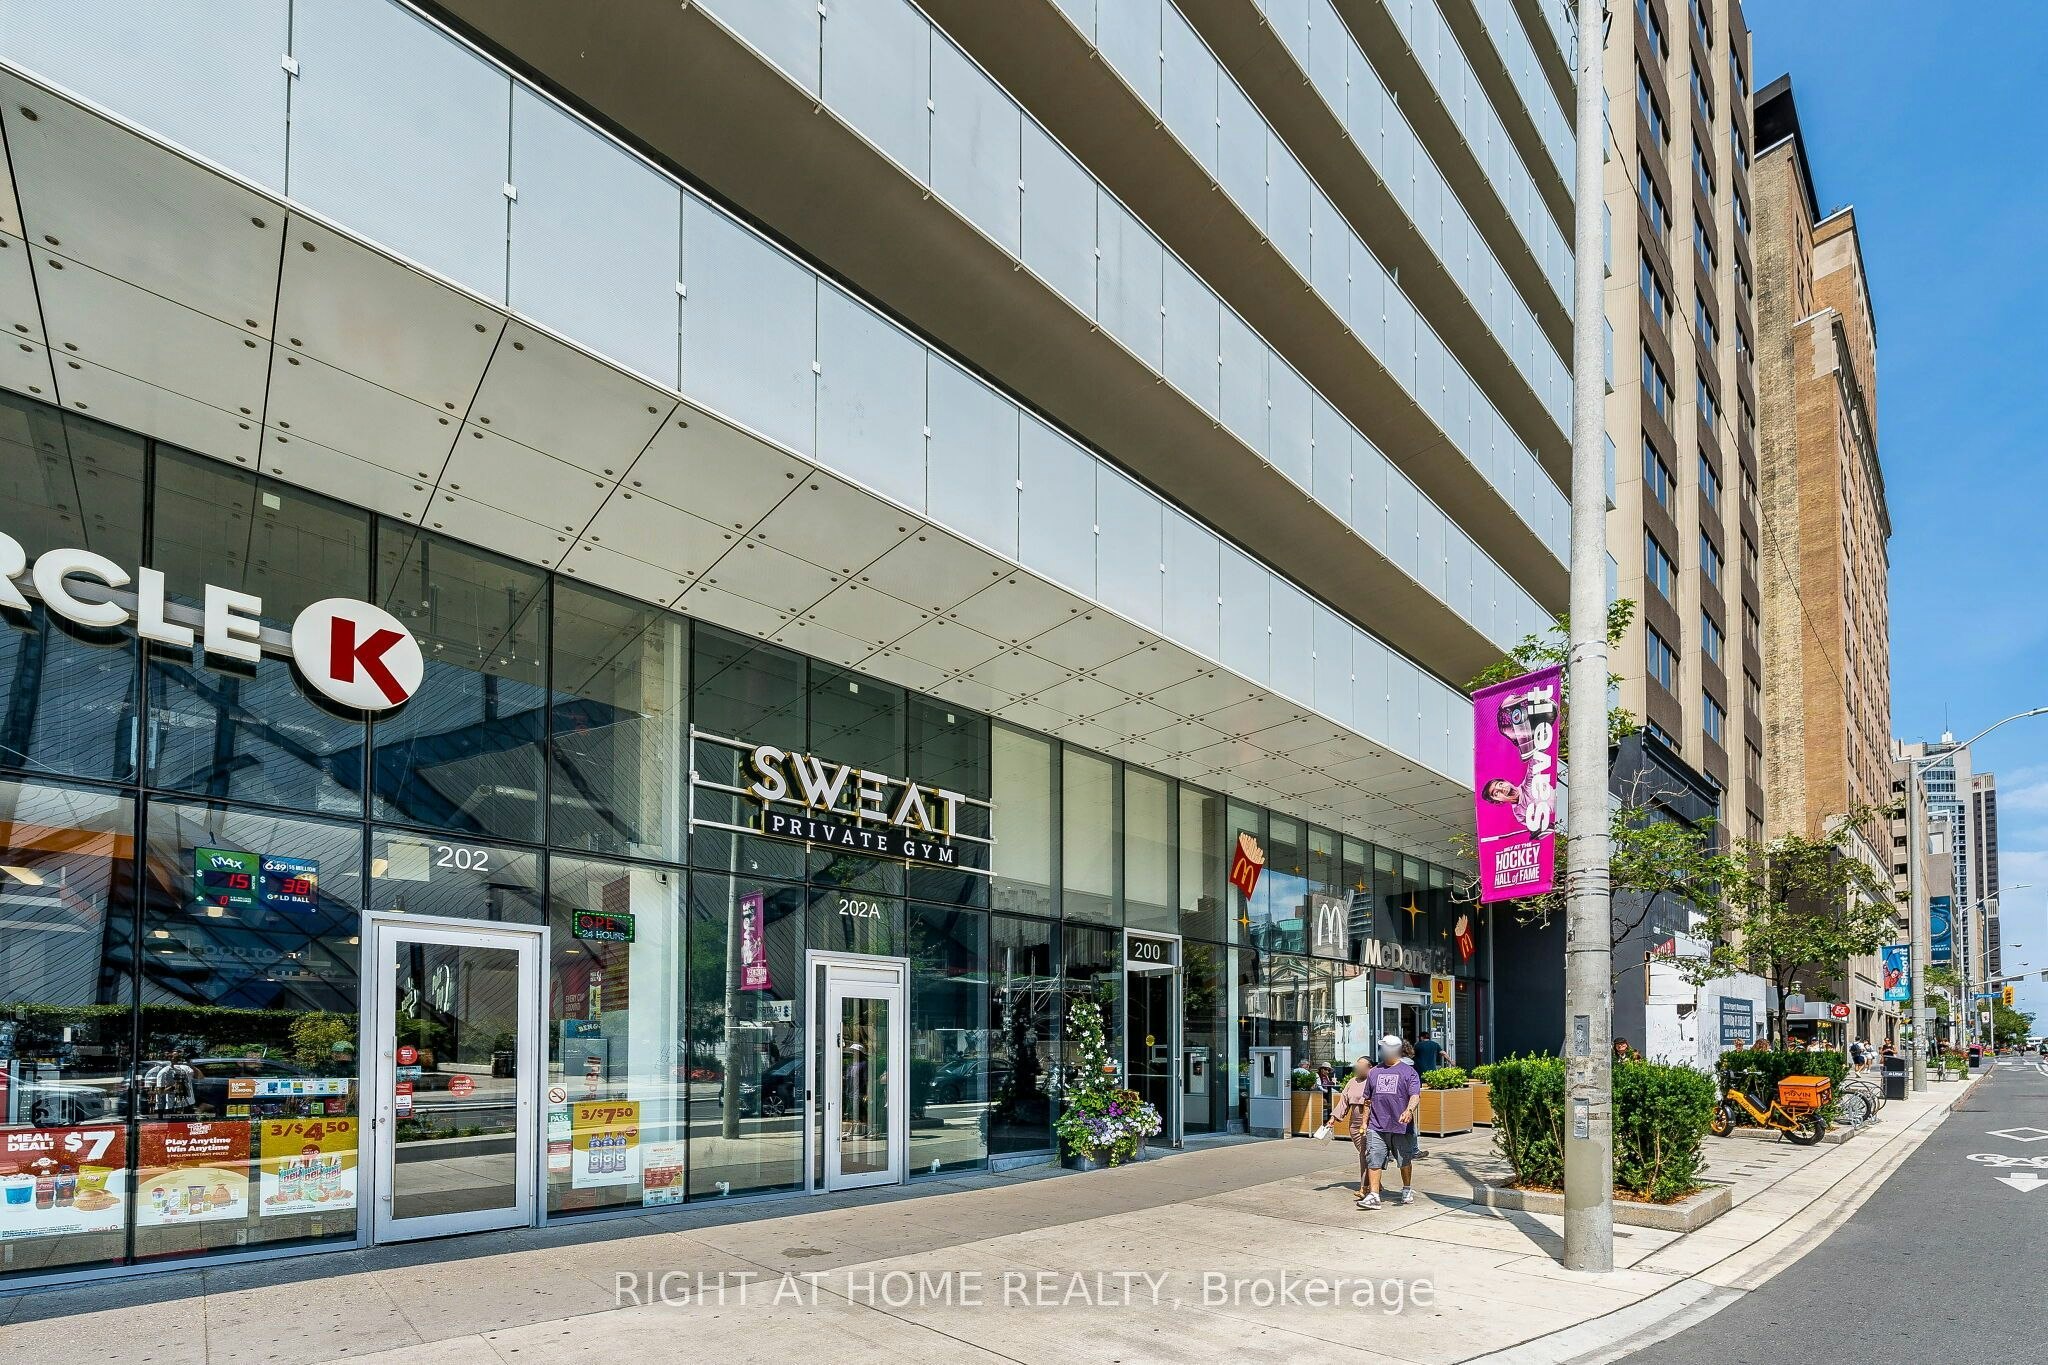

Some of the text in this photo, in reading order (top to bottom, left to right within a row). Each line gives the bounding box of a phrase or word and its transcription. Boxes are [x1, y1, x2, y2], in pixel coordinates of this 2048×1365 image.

[330, 616, 411, 706] K
[1528, 684, 1554, 715] it
[1526, 721, 1553, 833] save
[751, 746, 966, 837] SWEAT
[771, 815, 954, 864] PRIVATE GYM
[211, 855, 243, 870] MAX
[436, 846, 489, 872] 202
[1495, 846, 1541, 871] HOCKEY
[228, 874, 249, 889] 15
[1494, 872, 1511, 886] HALL
[1520, 866, 1540, 882] FAME
[282, 878, 310, 895] 38
[838, 899, 881, 919] 202A
[582, 930, 625, 940] 24 HOURS
[1134, 942, 1161, 960] 200
[1784, 1090, 1810, 1098] MOVIN
[550, 1114, 569, 1122] PASS
[8, 1132, 54, 1143] MEAL
[64, 1130, 116, 1160] $7
[165, 1136, 232, 1146] Play Anytime
[8, 1142, 55, 1152] DEAL!
[188, 1144, 230, 1153] Anytime
